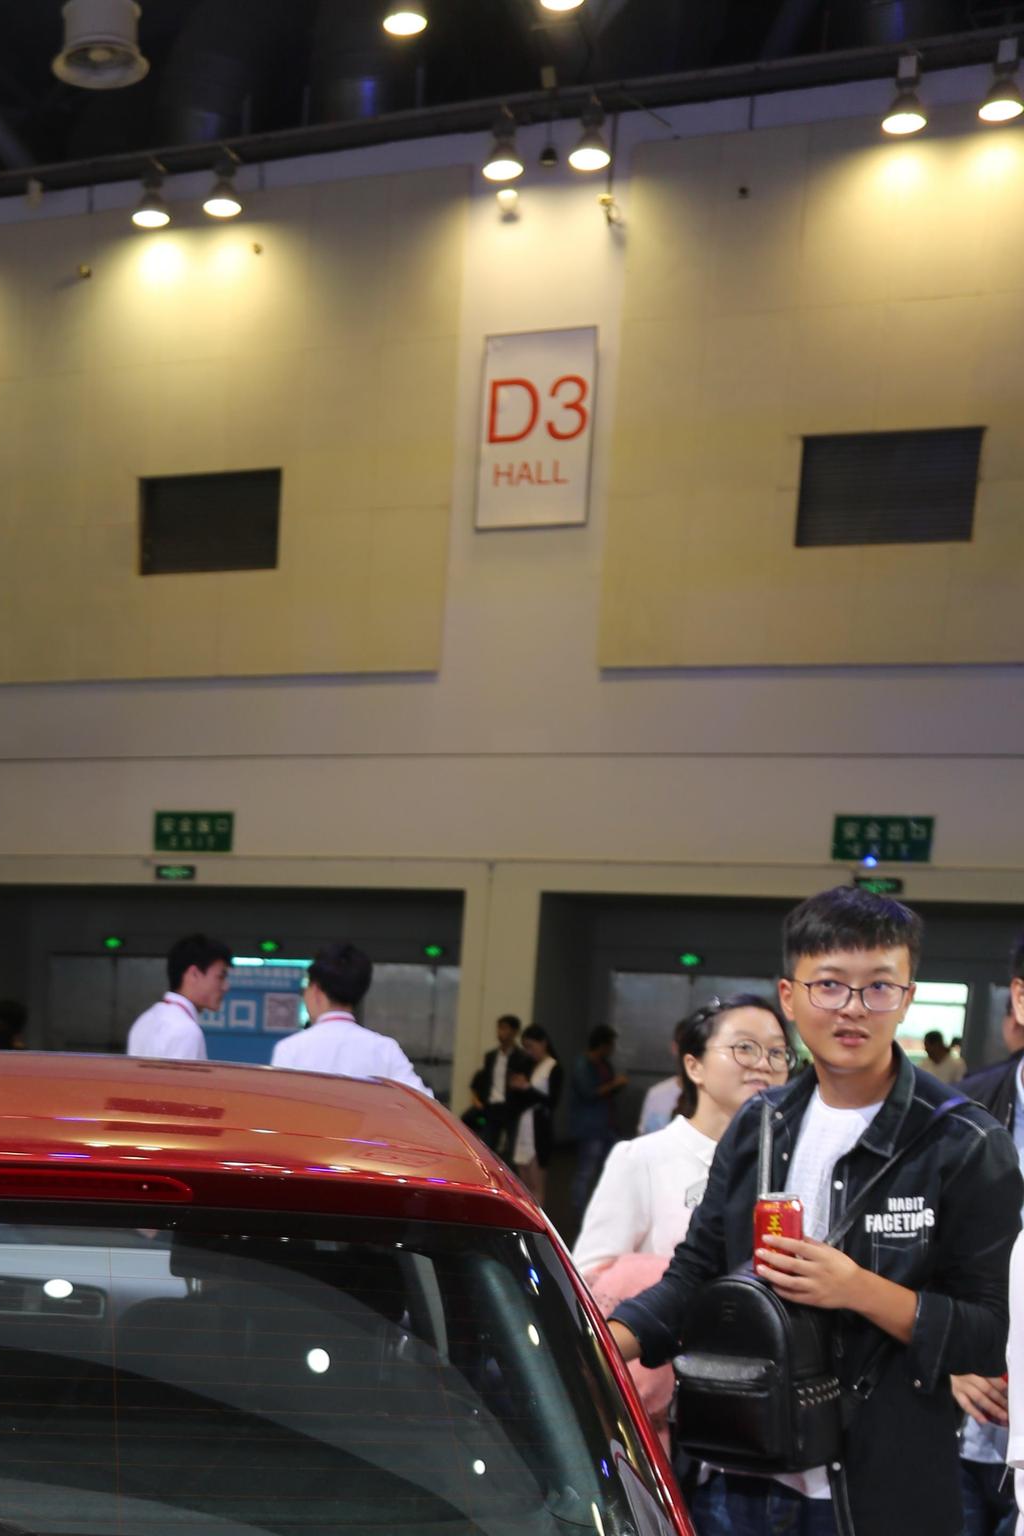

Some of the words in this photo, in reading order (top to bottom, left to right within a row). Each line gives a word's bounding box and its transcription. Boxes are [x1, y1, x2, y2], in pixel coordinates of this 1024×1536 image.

[488, 374, 589, 443] D3
[493, 460, 569, 487] HALL
[888, 1196, 925, 1212] HABIT
